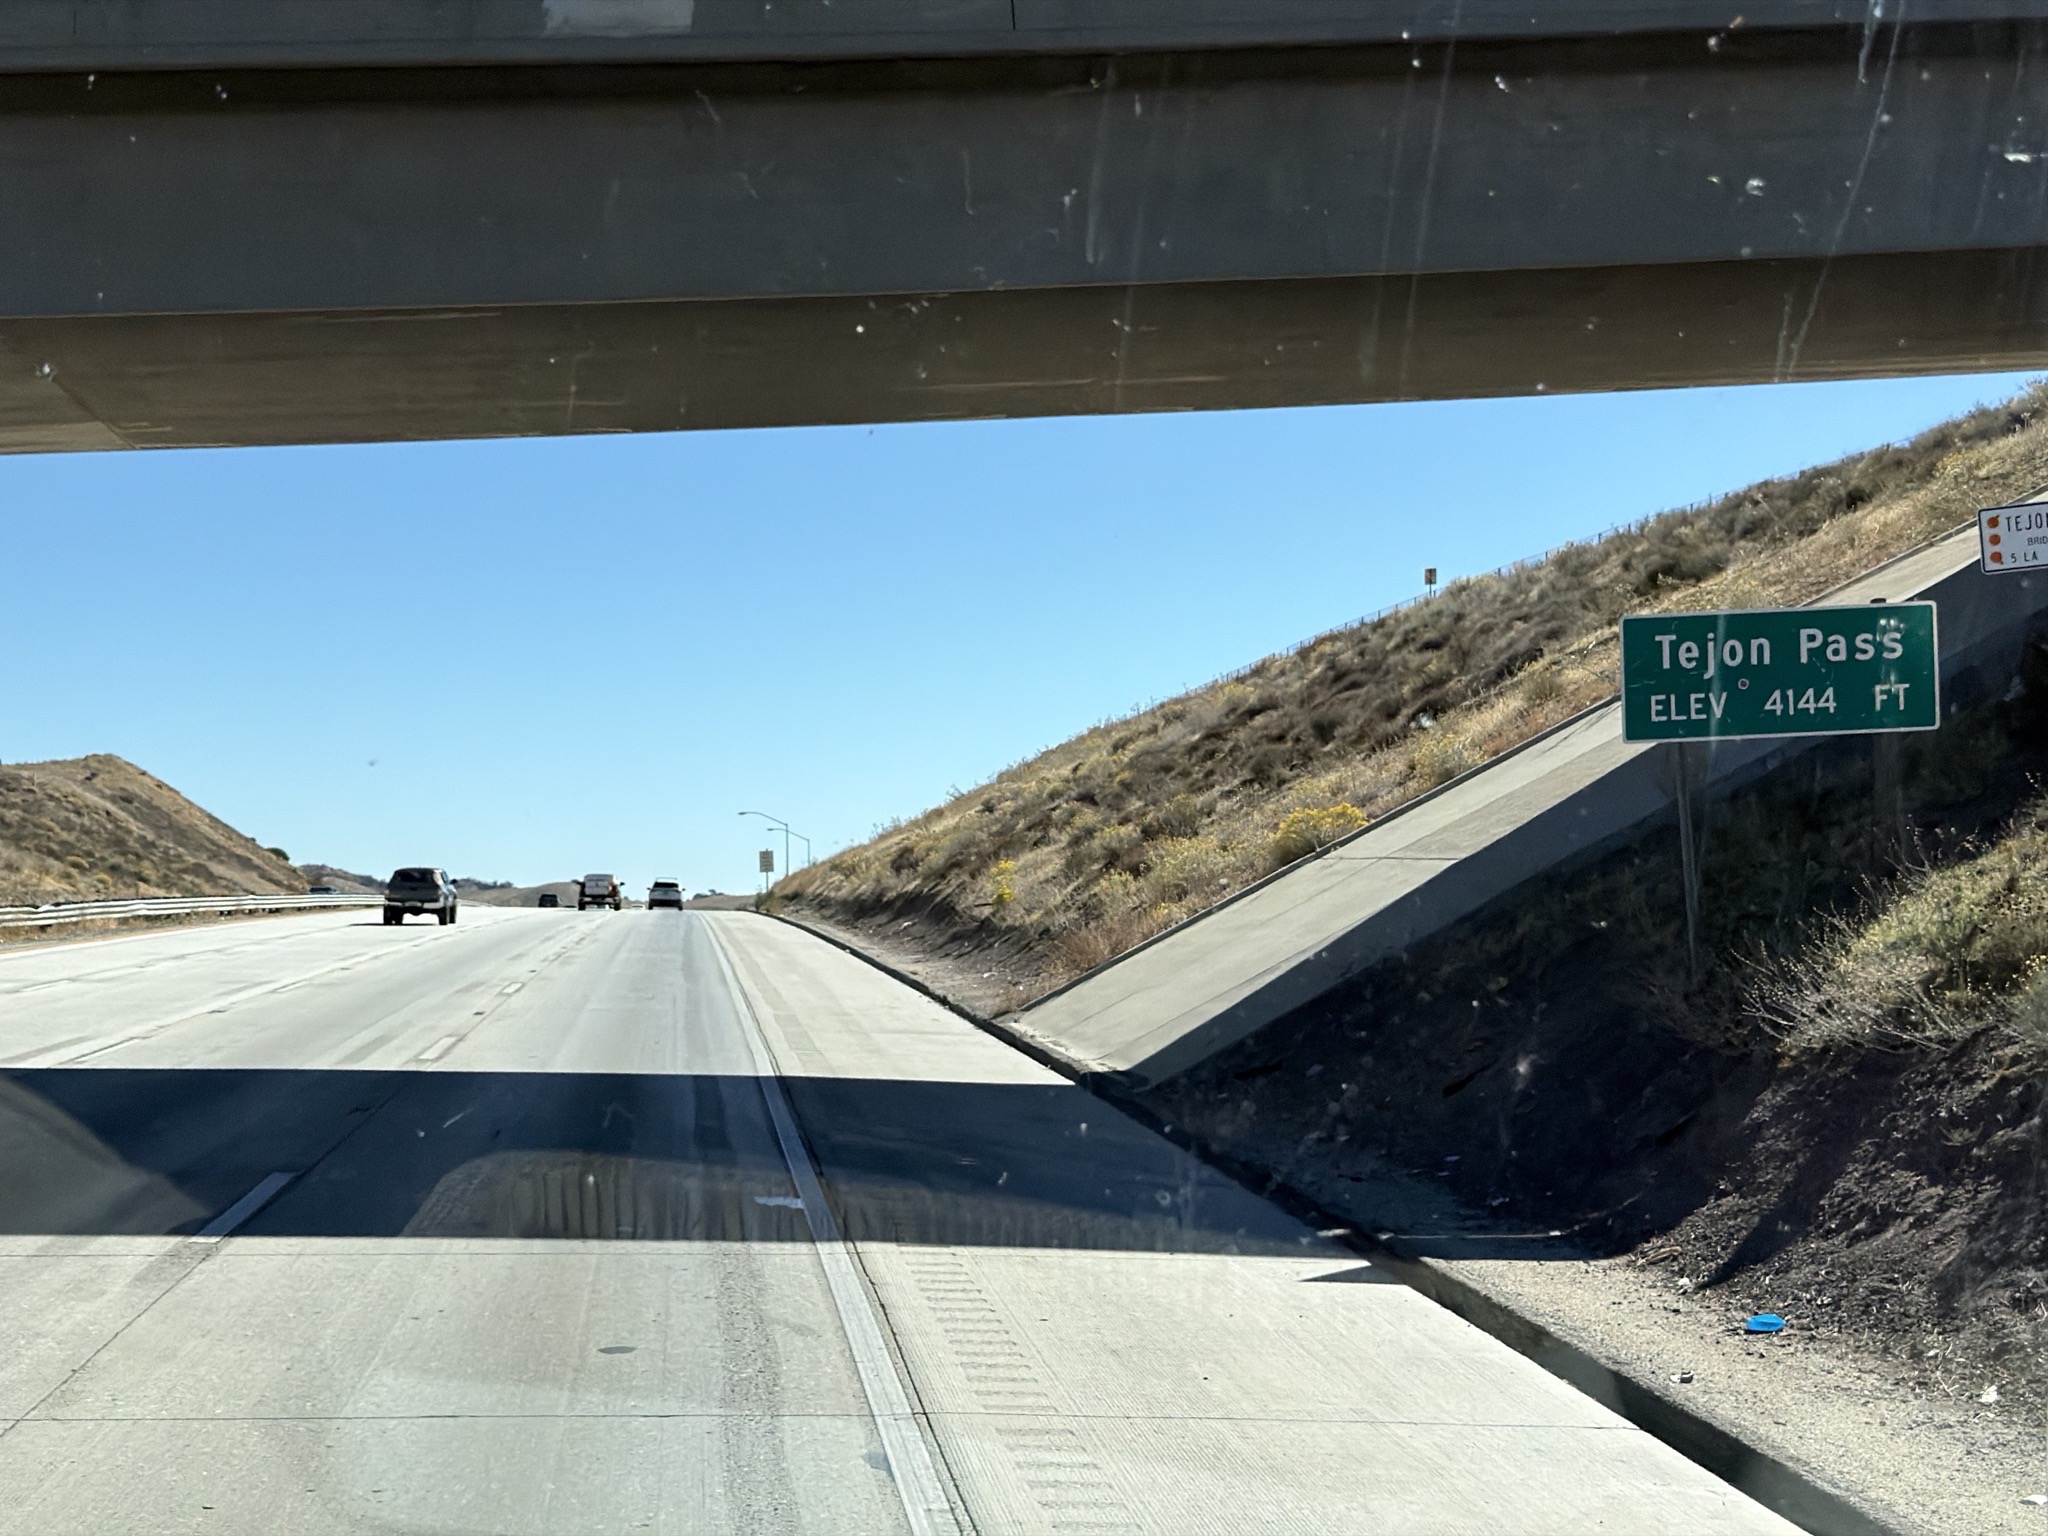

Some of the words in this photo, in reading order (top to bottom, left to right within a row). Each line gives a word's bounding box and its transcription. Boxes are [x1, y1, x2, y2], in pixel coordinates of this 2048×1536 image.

[2006, 512, 2048, 532] TEJO
[2023, 550, 2038, 562] LA
[1655, 632, 1771, 680] Tejon
[1800, 628, 1904, 664] Pass
[1650, 692, 1728, 722] ELEV
[1764, 687, 1837, 716] 4144
[1874, 684, 1911, 712] FT
